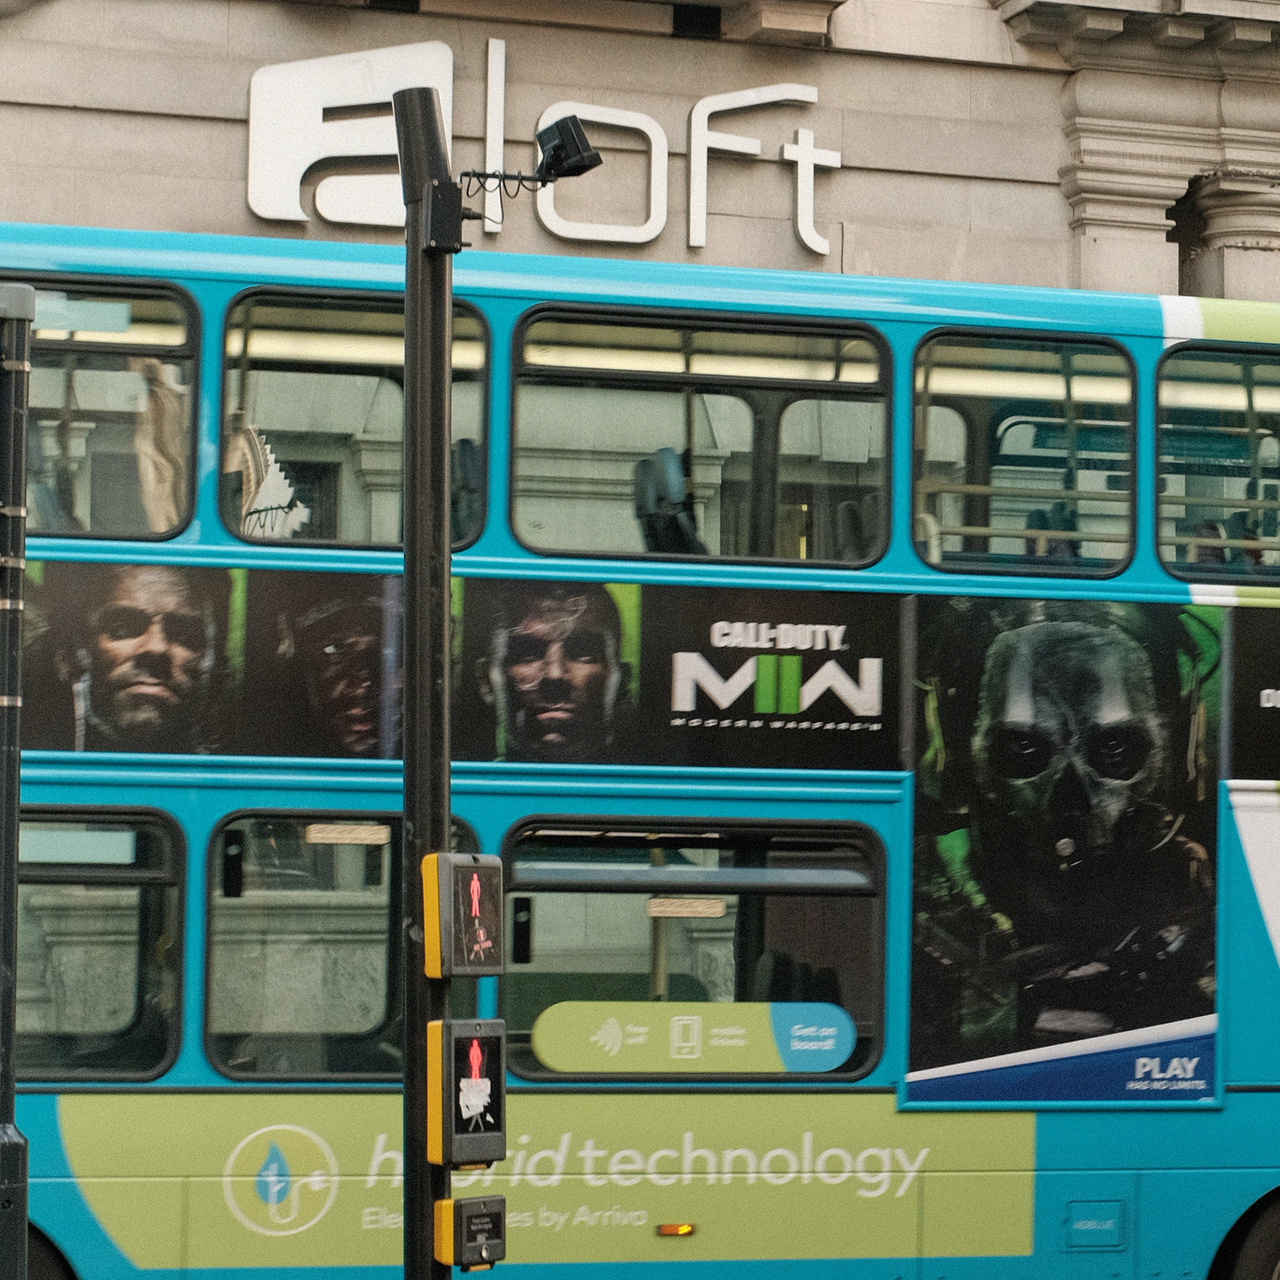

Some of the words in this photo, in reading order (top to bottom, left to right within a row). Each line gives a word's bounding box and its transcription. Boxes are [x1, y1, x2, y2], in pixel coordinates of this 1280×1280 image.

[248, 38, 842, 256] aloft
[1135, 1057, 1200, 1079] PLAY
[578, 1131, 929, 1197] technology
[538, 1205, 570, 1231] by
